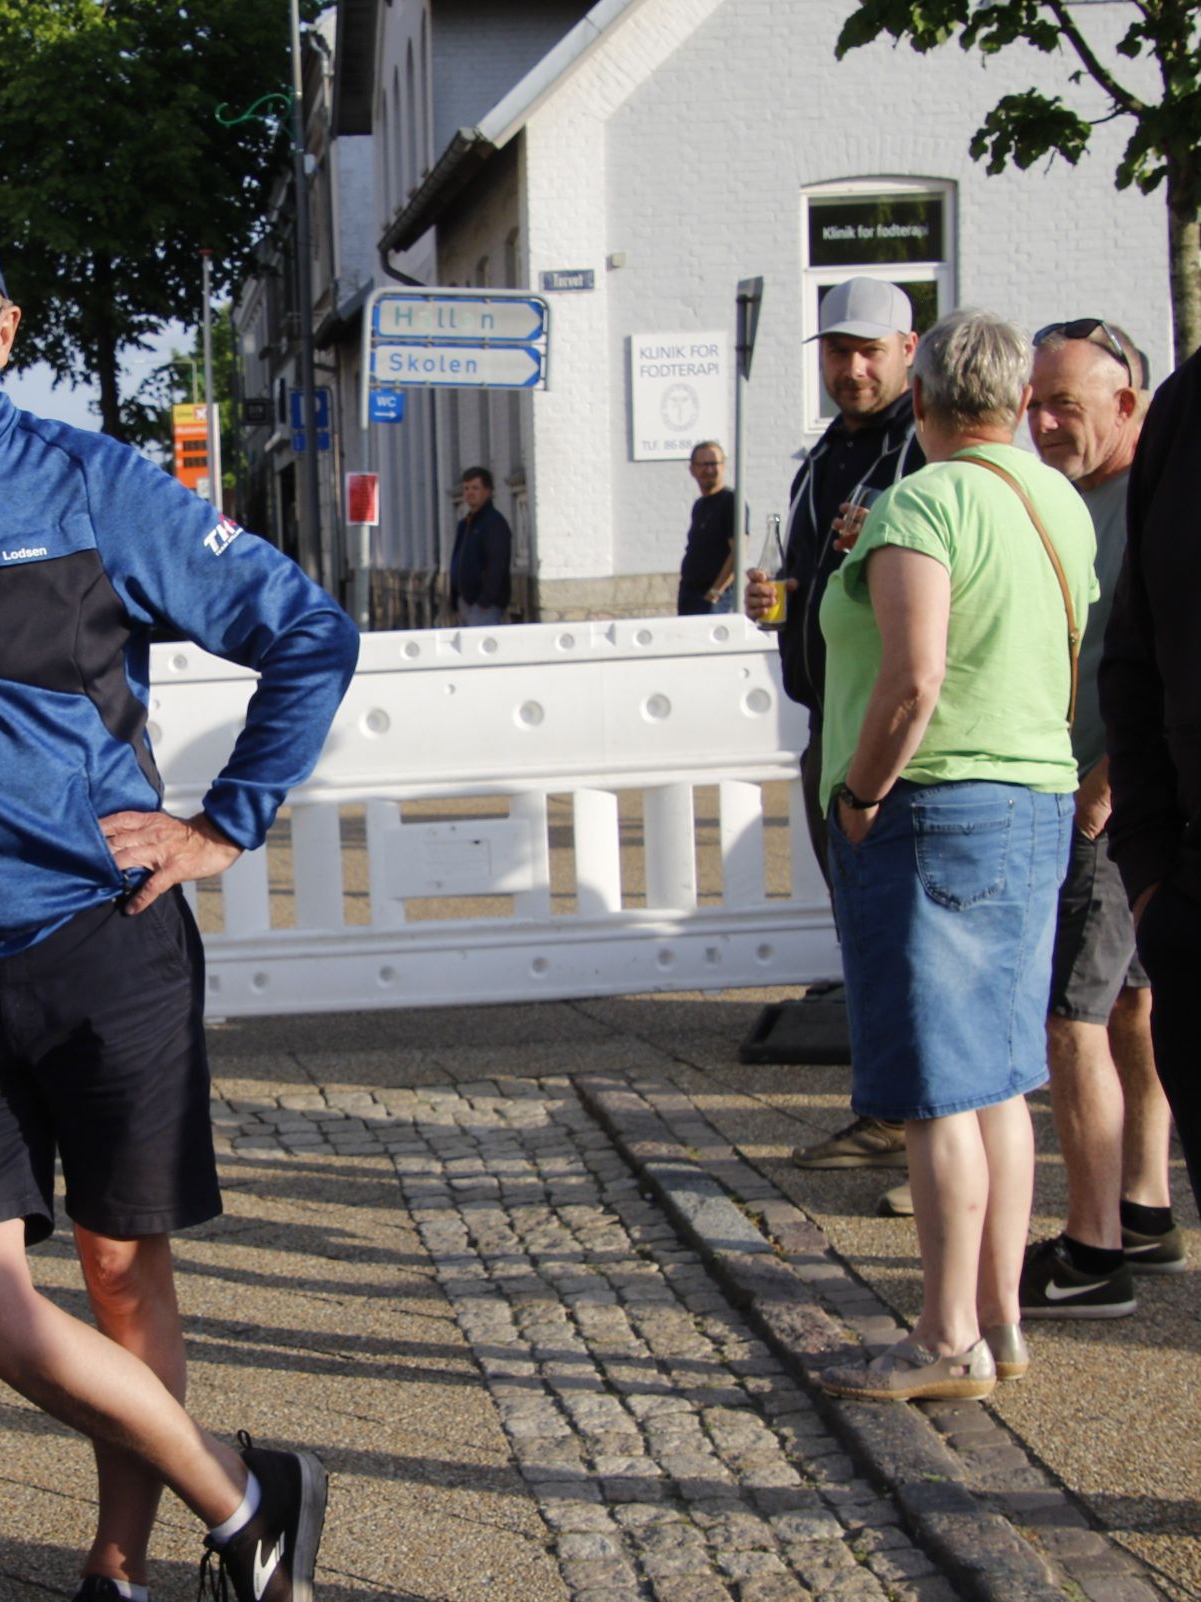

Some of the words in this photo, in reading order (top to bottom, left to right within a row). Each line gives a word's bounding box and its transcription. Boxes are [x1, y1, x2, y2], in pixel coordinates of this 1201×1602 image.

[822, 225, 856, 240] Klinik
[858, 224, 875, 238] for
[639, 345, 687, 359] KLINIK
[690, 344, 719, 358] FOR
[389, 353, 478, 373] Skolen
[640, 361, 719, 378] FODTERAPI
[376, 396, 397, 408] WC
[2, 546, 47, 561] Lodsen
